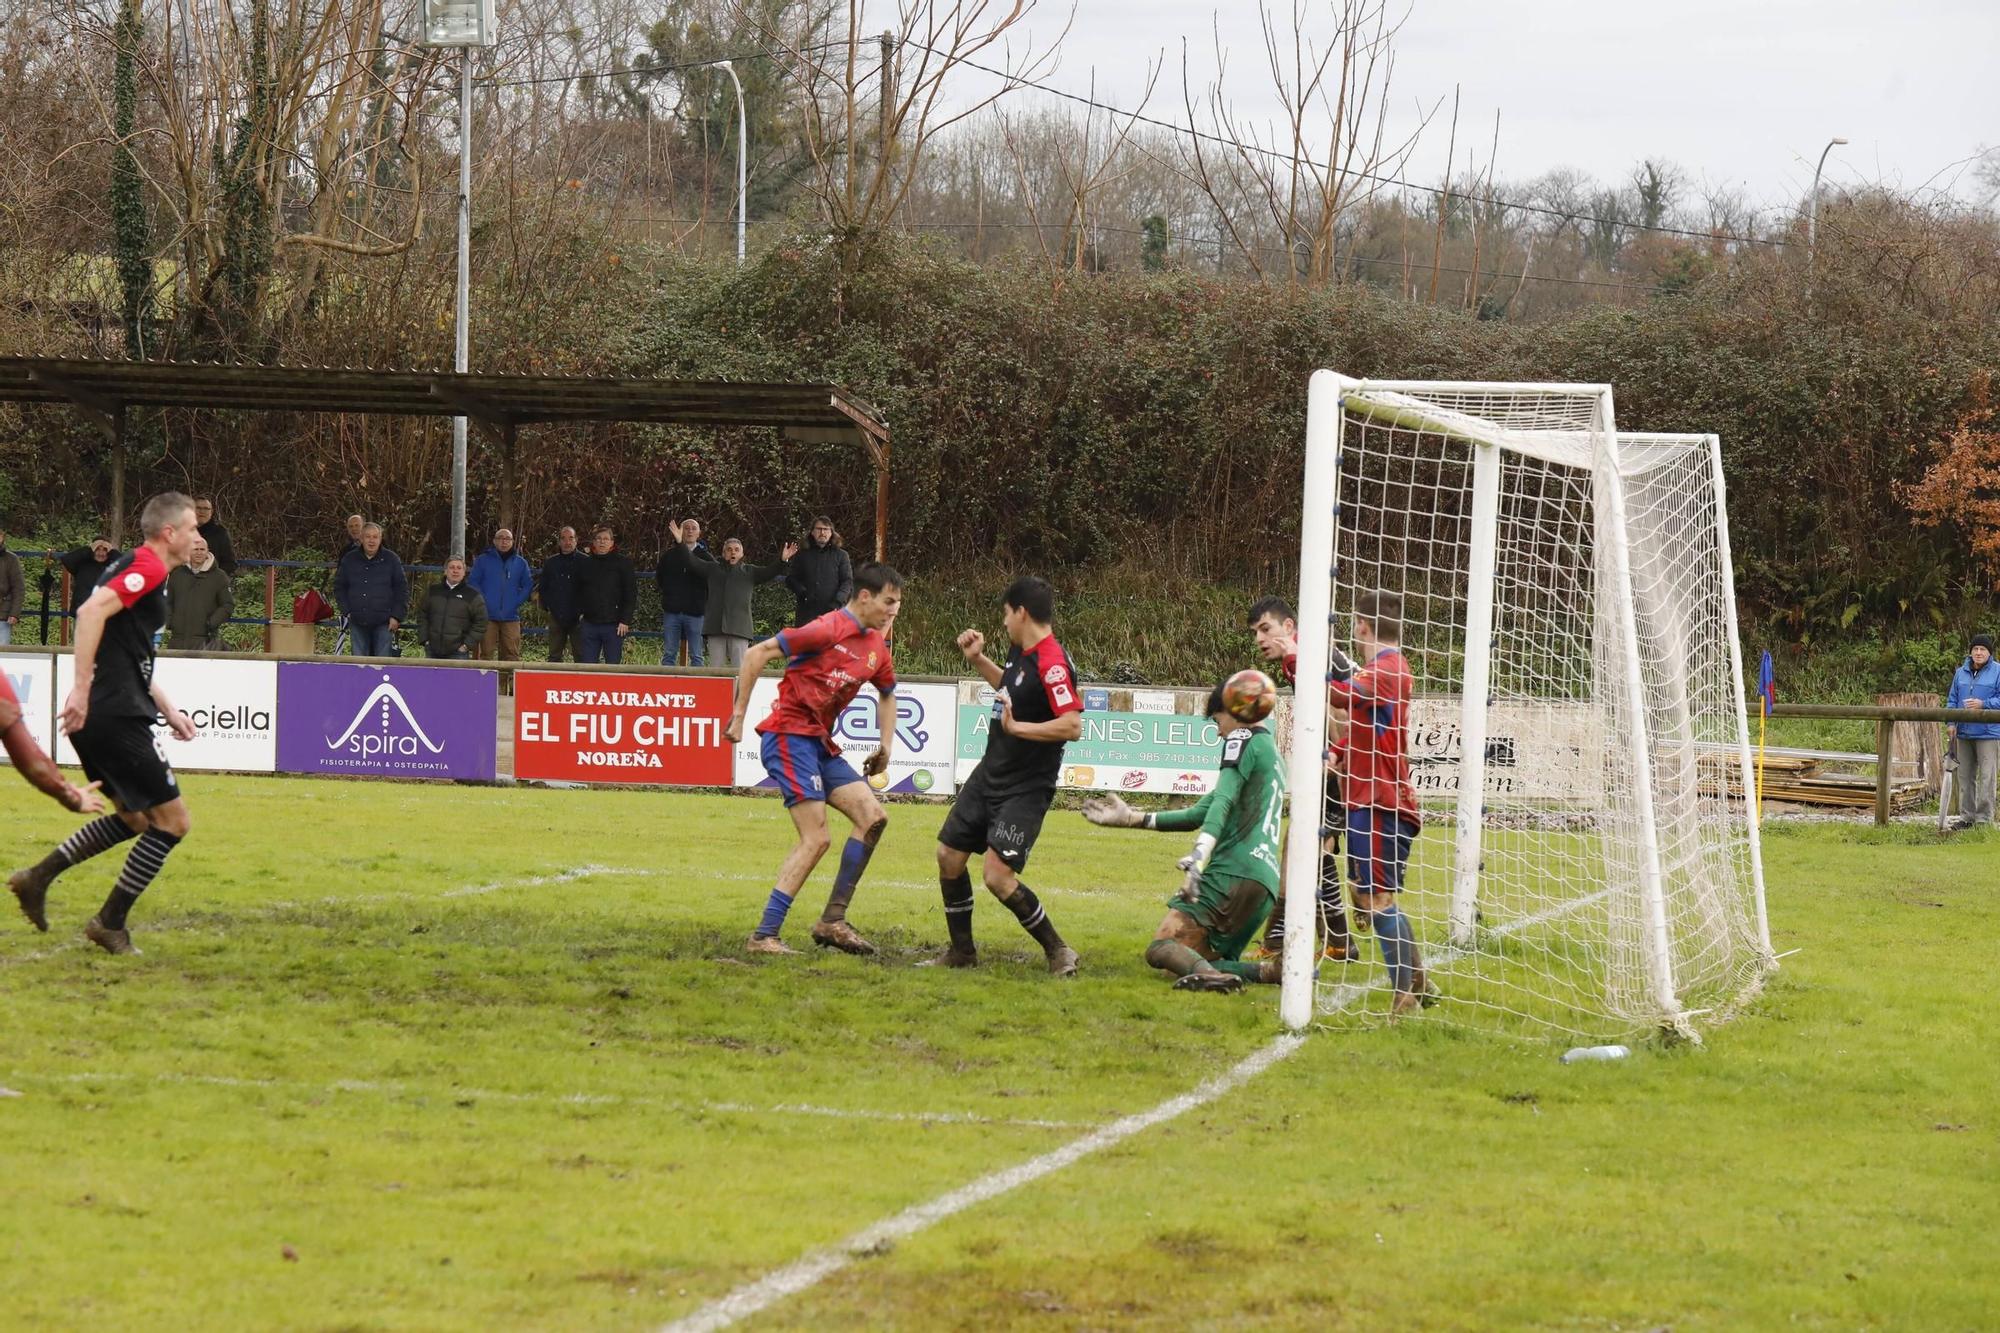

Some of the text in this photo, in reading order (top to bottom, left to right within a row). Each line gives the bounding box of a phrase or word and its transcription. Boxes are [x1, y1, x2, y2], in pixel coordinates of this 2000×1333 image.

[546, 690, 696, 708] RESTAURANTE
[521, 712, 721, 748] EL FIU CHITI
[320, 759, 382, 767] FISIOTERAPIA
[576, 750, 663, 768] NOREÑA
[1172, 782, 1207, 792] Red Bull
